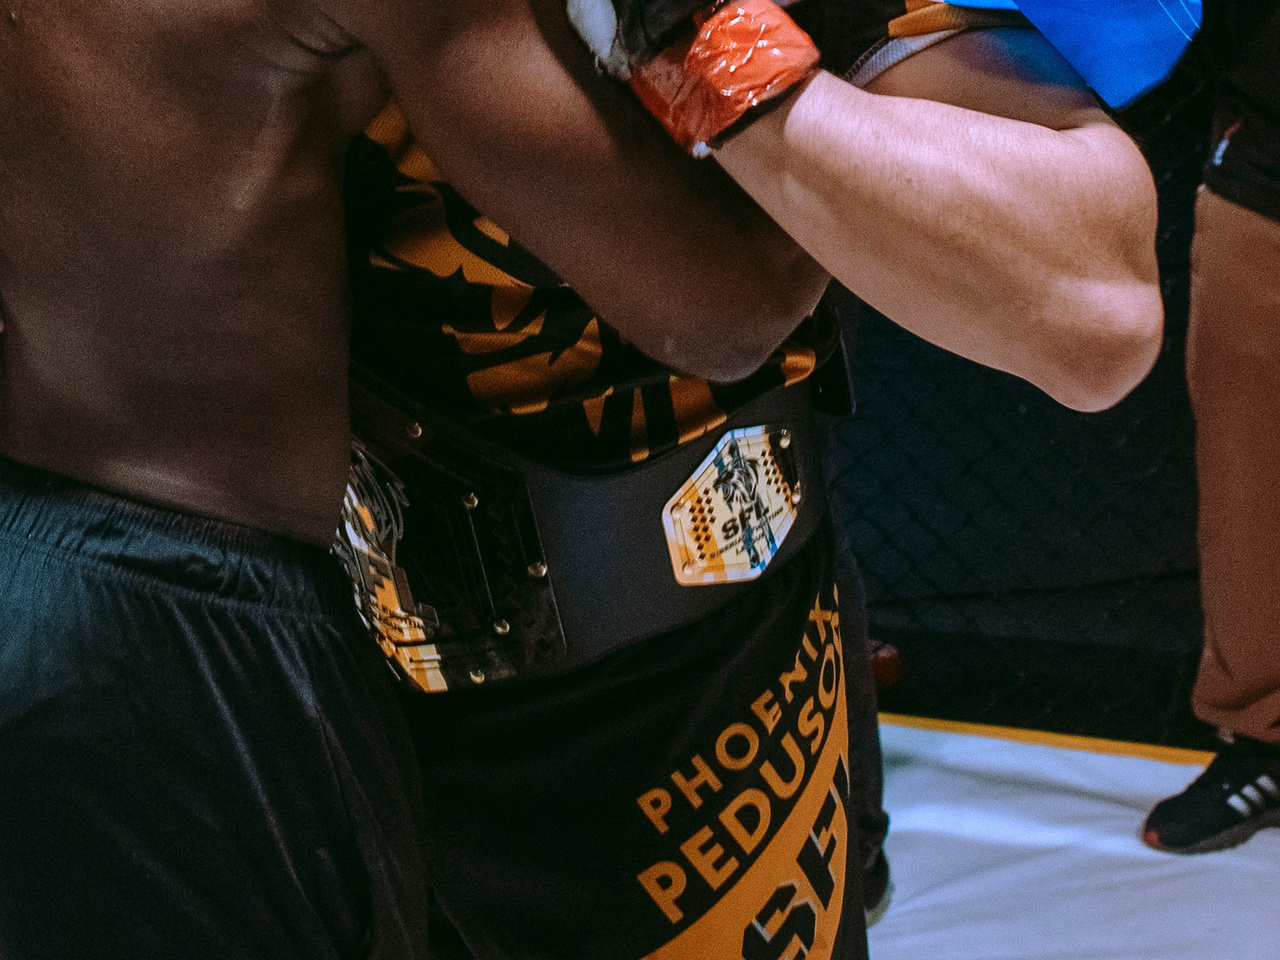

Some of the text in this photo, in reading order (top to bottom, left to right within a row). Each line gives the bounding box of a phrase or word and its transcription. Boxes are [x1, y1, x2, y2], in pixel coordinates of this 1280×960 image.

[721, 503, 770, 541] SFL
[635, 592, 833, 836] PHOENIX
[740, 750, 851, 960] SF
